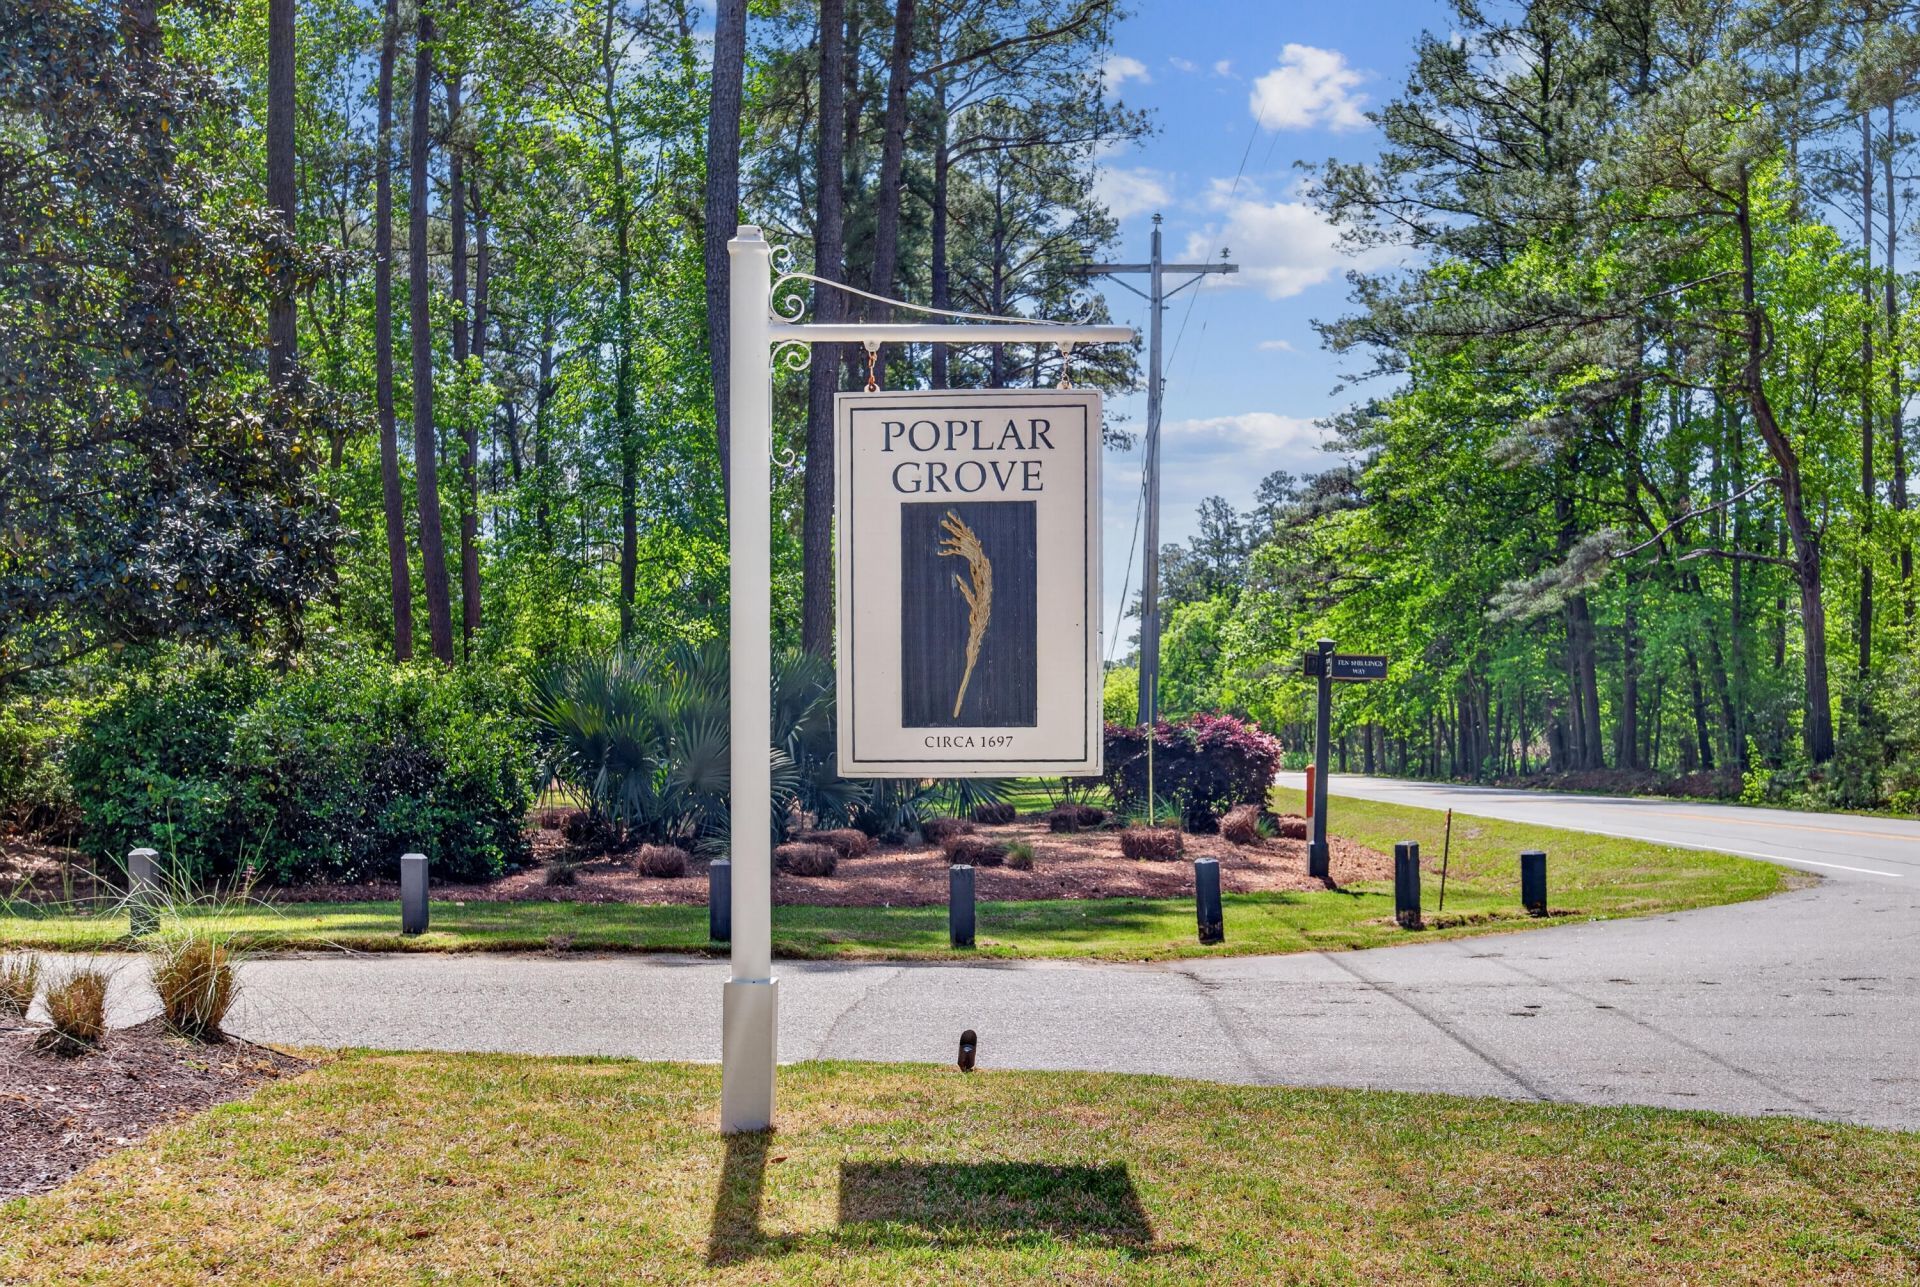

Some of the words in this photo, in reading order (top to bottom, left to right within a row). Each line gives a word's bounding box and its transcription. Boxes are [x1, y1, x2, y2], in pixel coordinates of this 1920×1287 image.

[880, 418, 1056, 453] POPLAR
[892, 460, 1044, 494] GROVE
[924, 736, 975, 748] CIRCA
[980, 736, 1014, 748] 1697
